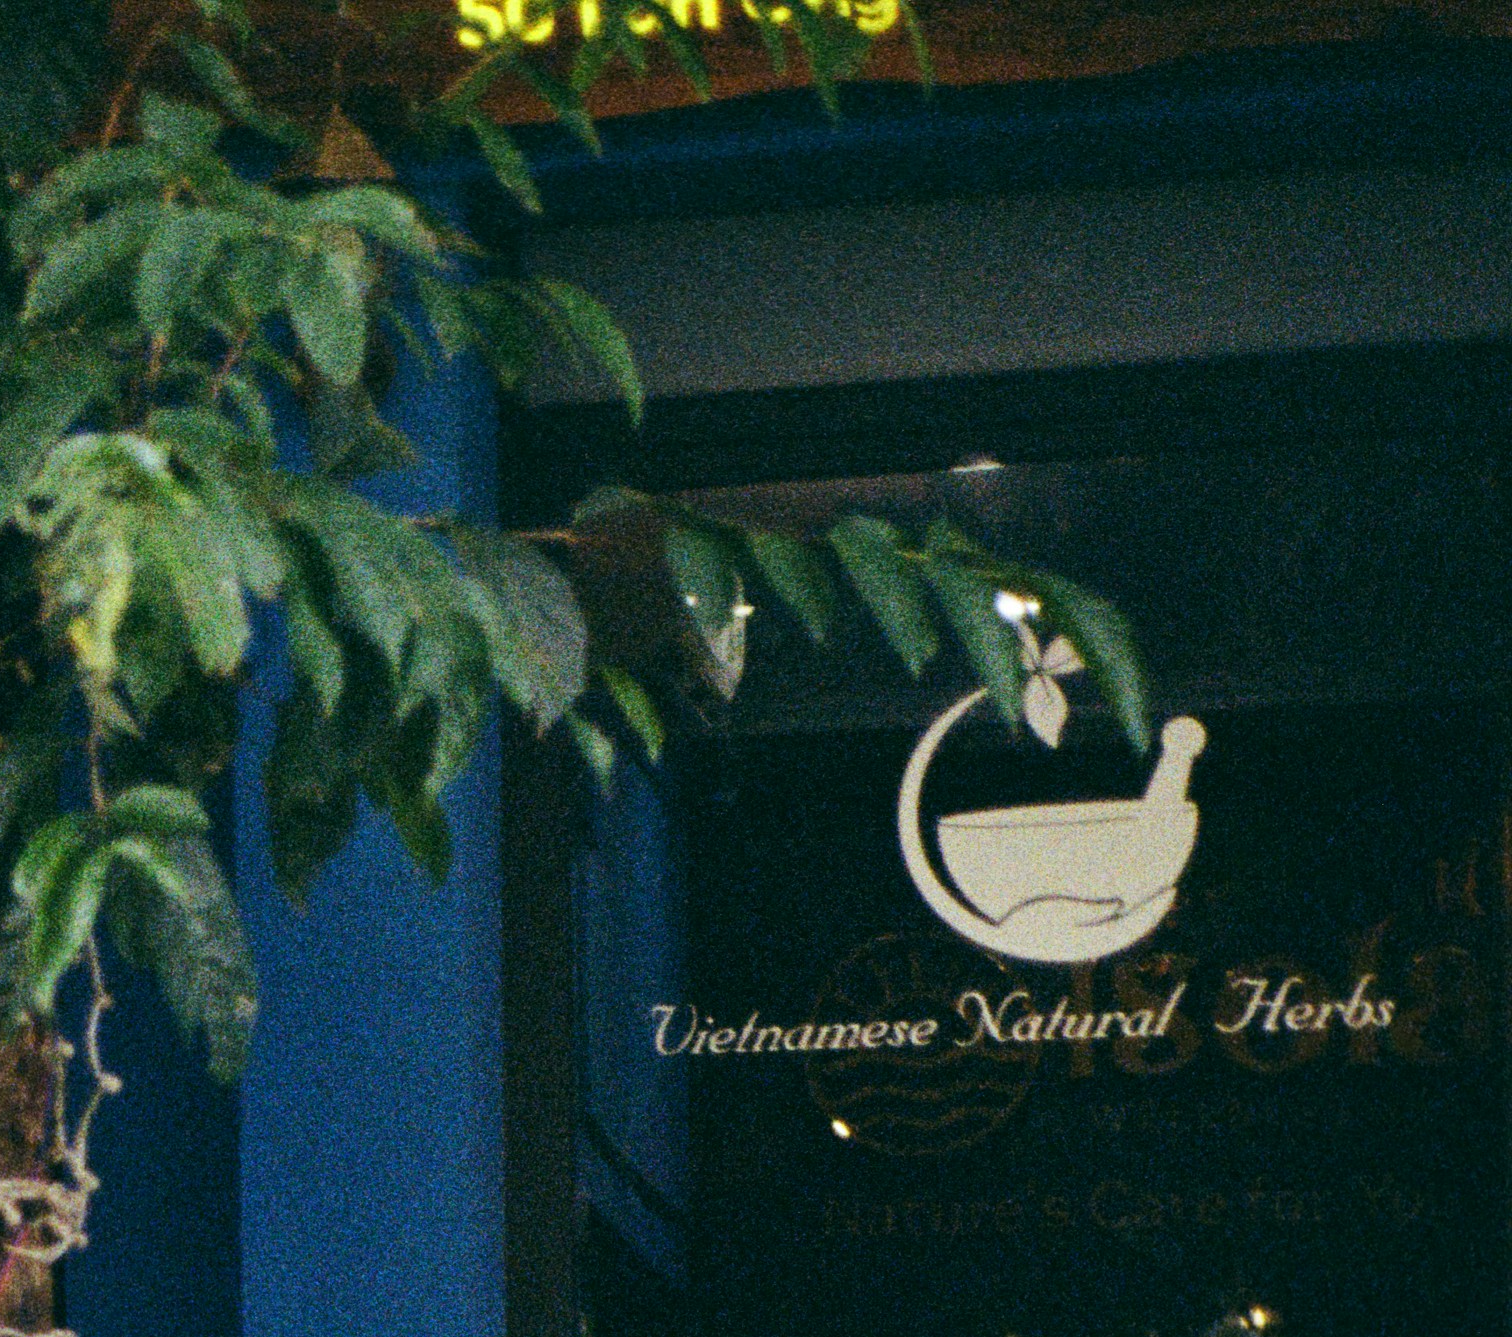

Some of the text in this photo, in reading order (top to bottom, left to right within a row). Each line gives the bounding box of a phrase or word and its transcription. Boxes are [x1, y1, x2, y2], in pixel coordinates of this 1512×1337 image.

[650, 975, 1396, 1059] Vietnamese Natural Herbs
